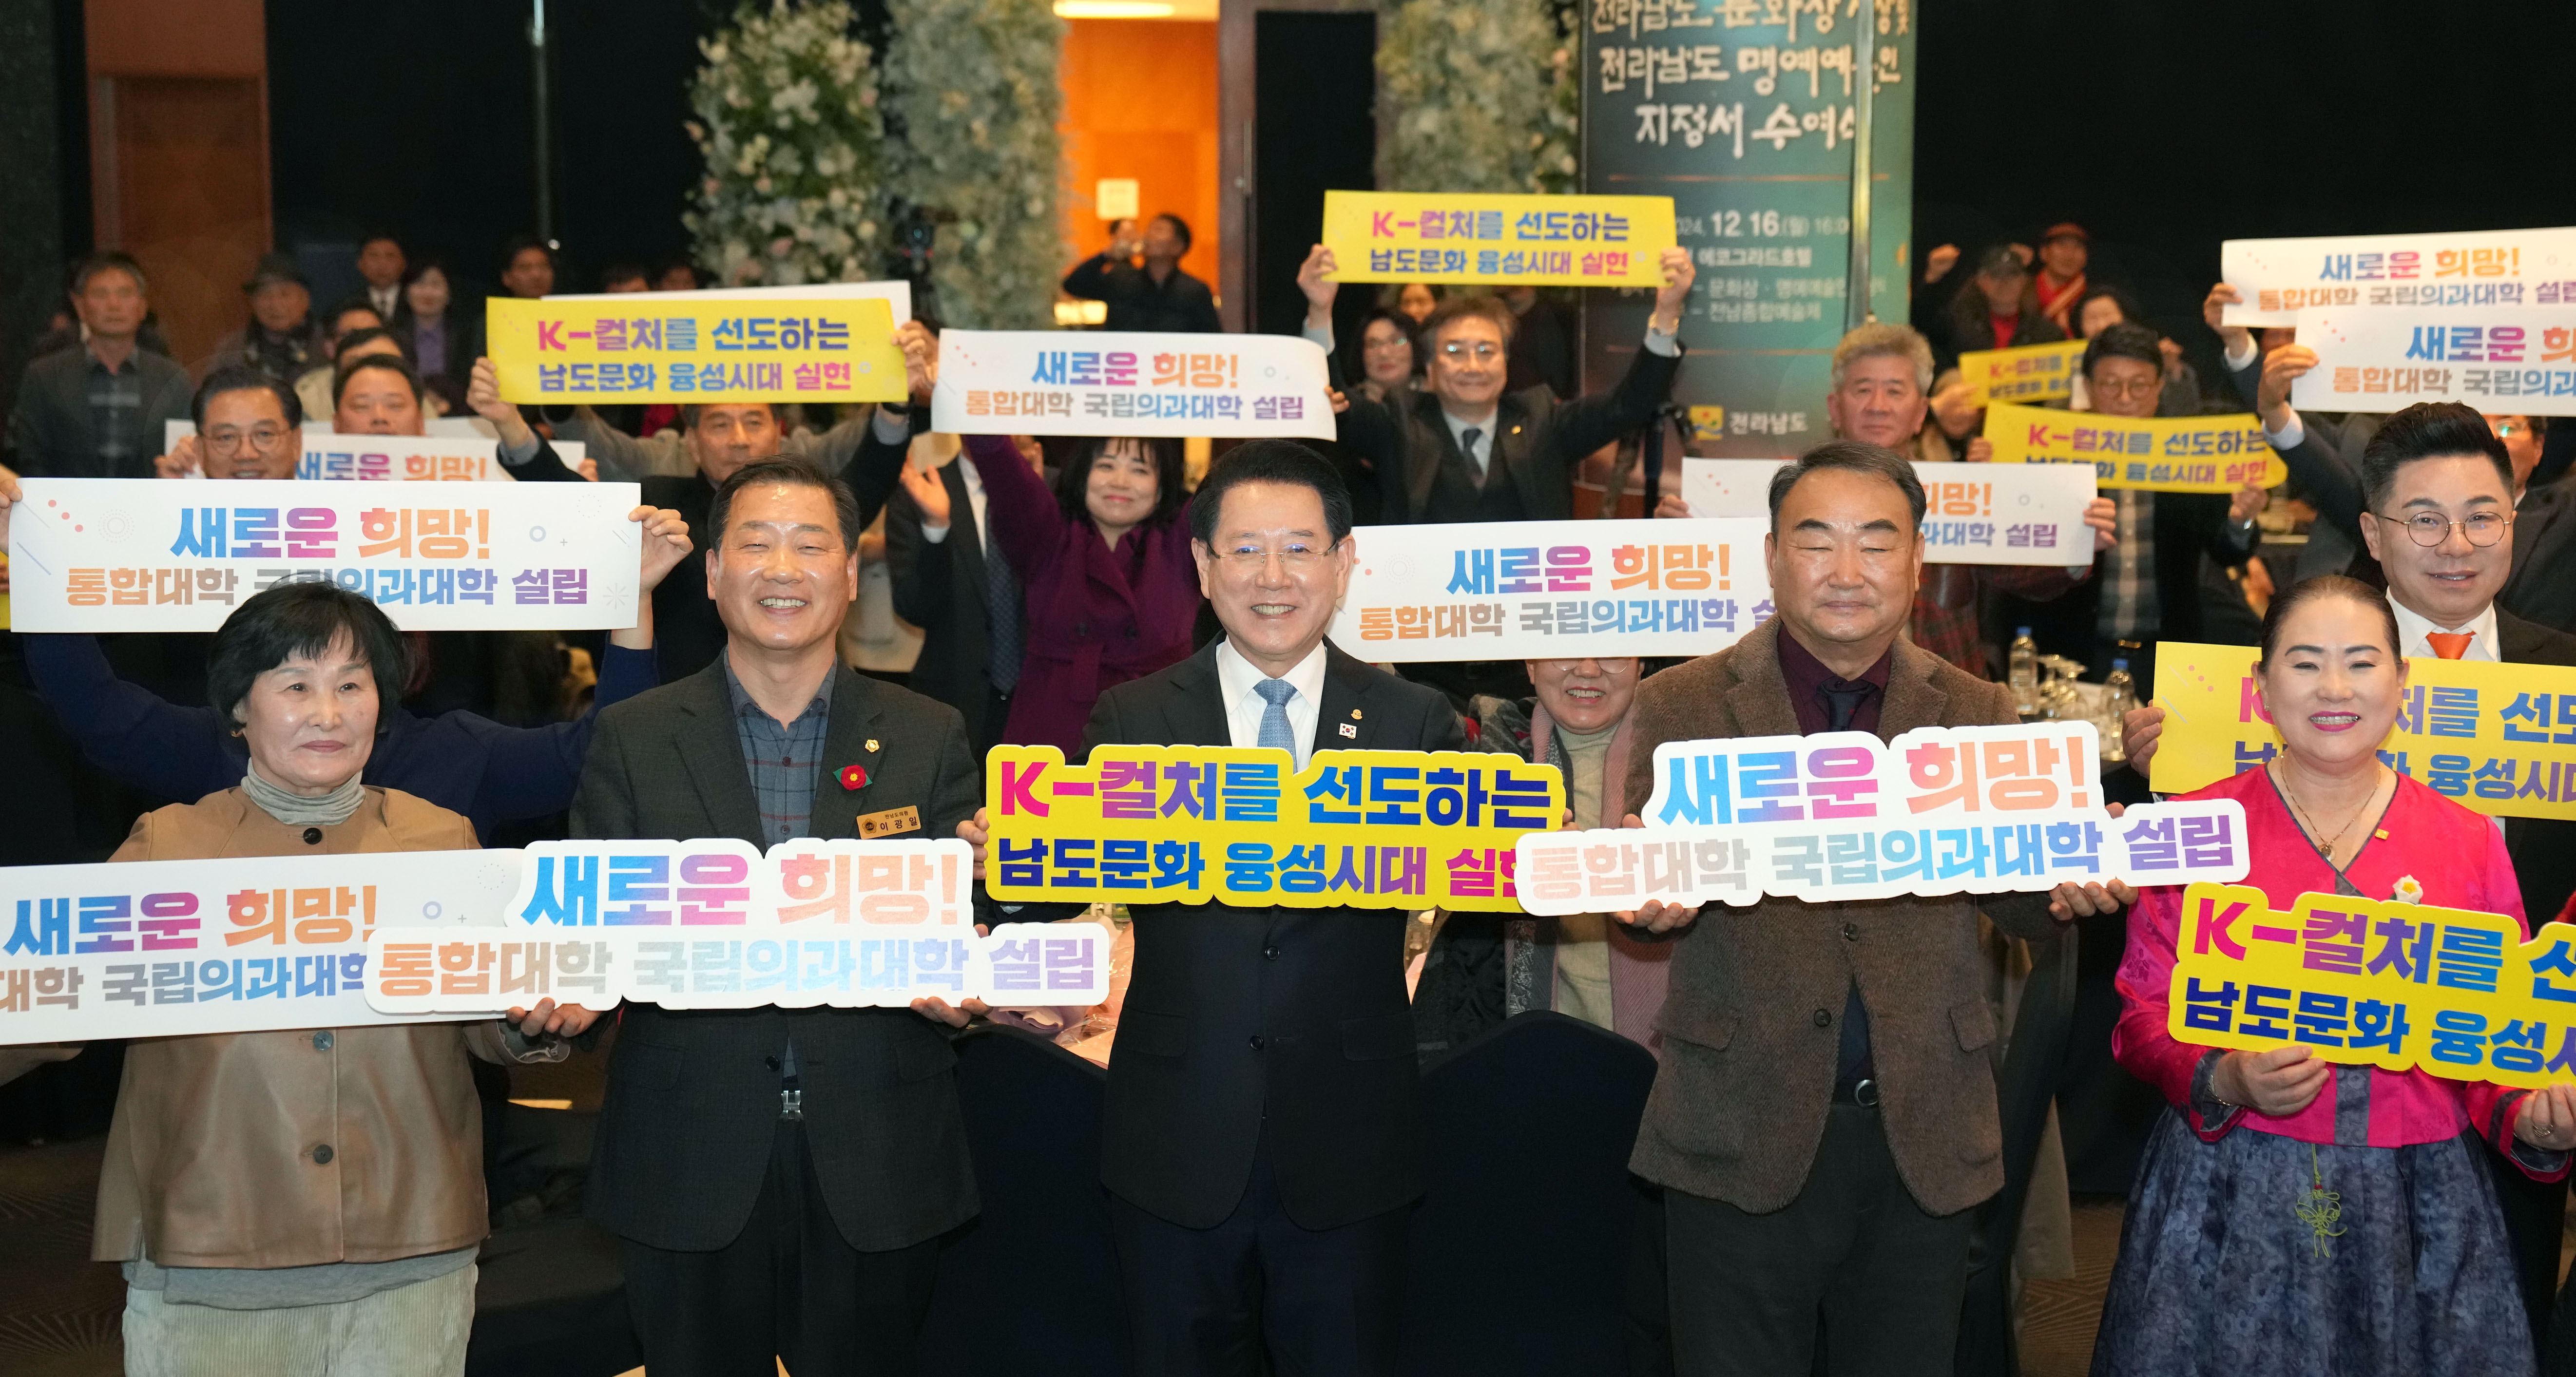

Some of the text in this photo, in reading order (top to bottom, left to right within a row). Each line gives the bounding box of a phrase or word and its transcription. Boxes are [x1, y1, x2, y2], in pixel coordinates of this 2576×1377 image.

[1599, 44, 1901, 99] 전라남도 명예예인
[1635, 103, 1744, 159] 지정서
[1372, 210, 1629, 241] K-컬처를 선도하는
[1370, 249, 1628, 275] 남도문화 융성시대 실현
[2320, 248, 2521, 281] 새로운 희망!
[2258, 286, 2360, 312] 통합대학
[2369, 282, 2525, 307] 국립의과대학
[538, 318, 849, 352] K-컬처를 선도하는
[2406, 325, 2526, 362] 새로운
[539, 362, 851, 392] 남도문화 융성시대 실현
[1031, 351, 1238, 388] 새로운 희망!
[2333, 367, 2452, 395] 통합대학
[966, 390, 1304, 421] 통합대학 국립의과대학 설립
[2028, 424, 2267, 457] K-컬처를 선도하는
[295, 453, 390, 480] 새로운
[170, 507, 490, 559] 새로운 희망!
[1921, 522, 2057, 547] 과대학 설립
[66, 568, 239, 607] 통합대학
[512, 568, 587, 605] 설립
[1446, 543, 1731, 595] 새로운 희망!
[1359, 603, 1505, 641] 통합대학
[1519, 599, 1738, 635] 국립의과대학
[1000, 761, 1551, 829] K-컬처를 선도하는
[1658, 736, 2090, 827] 새로운 희망!
[999, 838, 1205, 890] 남도문화
[1225, 842, 1427, 897] 융성시대
[1530, 814, 2231, 899] 통합대학 국립의과대학 설립
[520, 853, 958, 927] 새로운 희망!
[2, 885, 377, 956] 새로운 희망!
[378, 937, 1095, 997] 통합대학 국립의과대학 설립
[2193, 898, 2504, 994] K-컬처를
[0, 967, 83, 1013] 대학
[2185, 977, 2411, 1055] 남도문화
